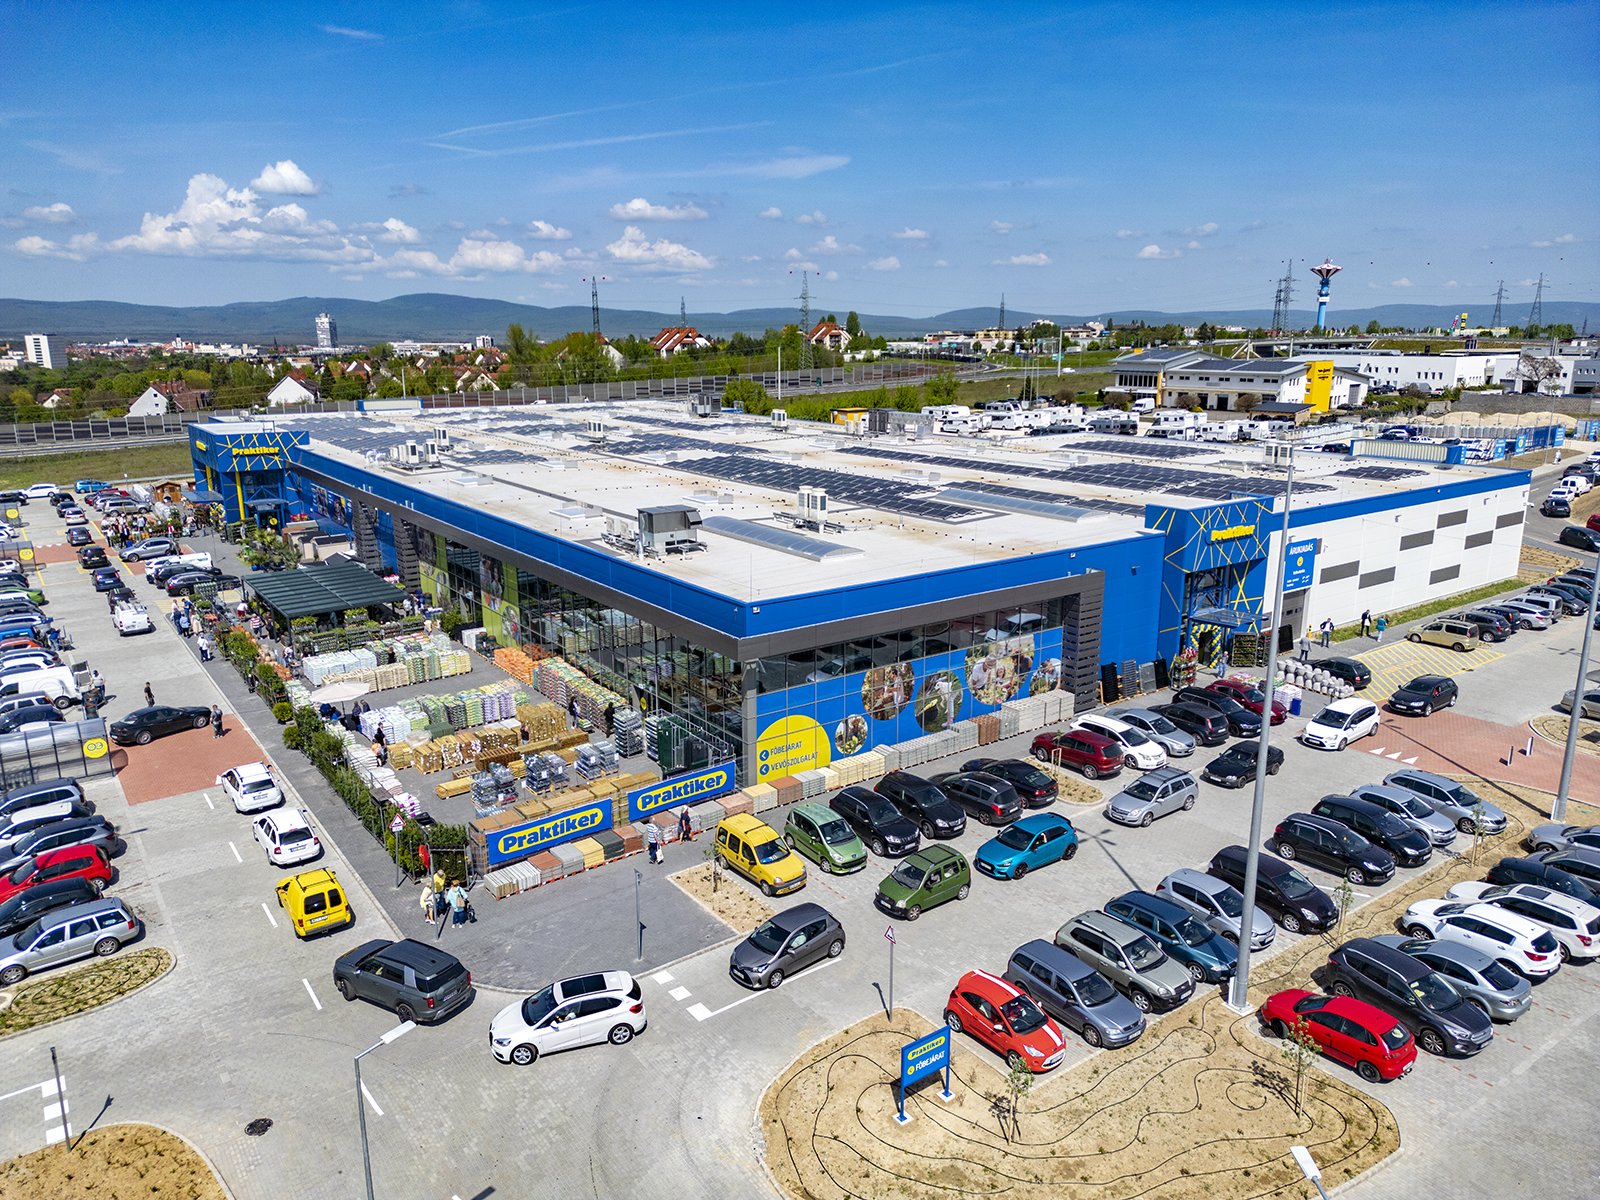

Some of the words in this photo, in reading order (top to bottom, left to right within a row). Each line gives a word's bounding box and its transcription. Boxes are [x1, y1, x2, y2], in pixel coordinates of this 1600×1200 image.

[231, 446, 280, 456] Praktiker
[1210, 525, 1256, 542] Praktiker
[640, 772, 724, 810] Praktiker
[502, 810, 599, 852] Praktiker
[911, 1038, 943, 1058] Praktiker
[915, 1050, 945, 1072] FŐBEJÁRAT
